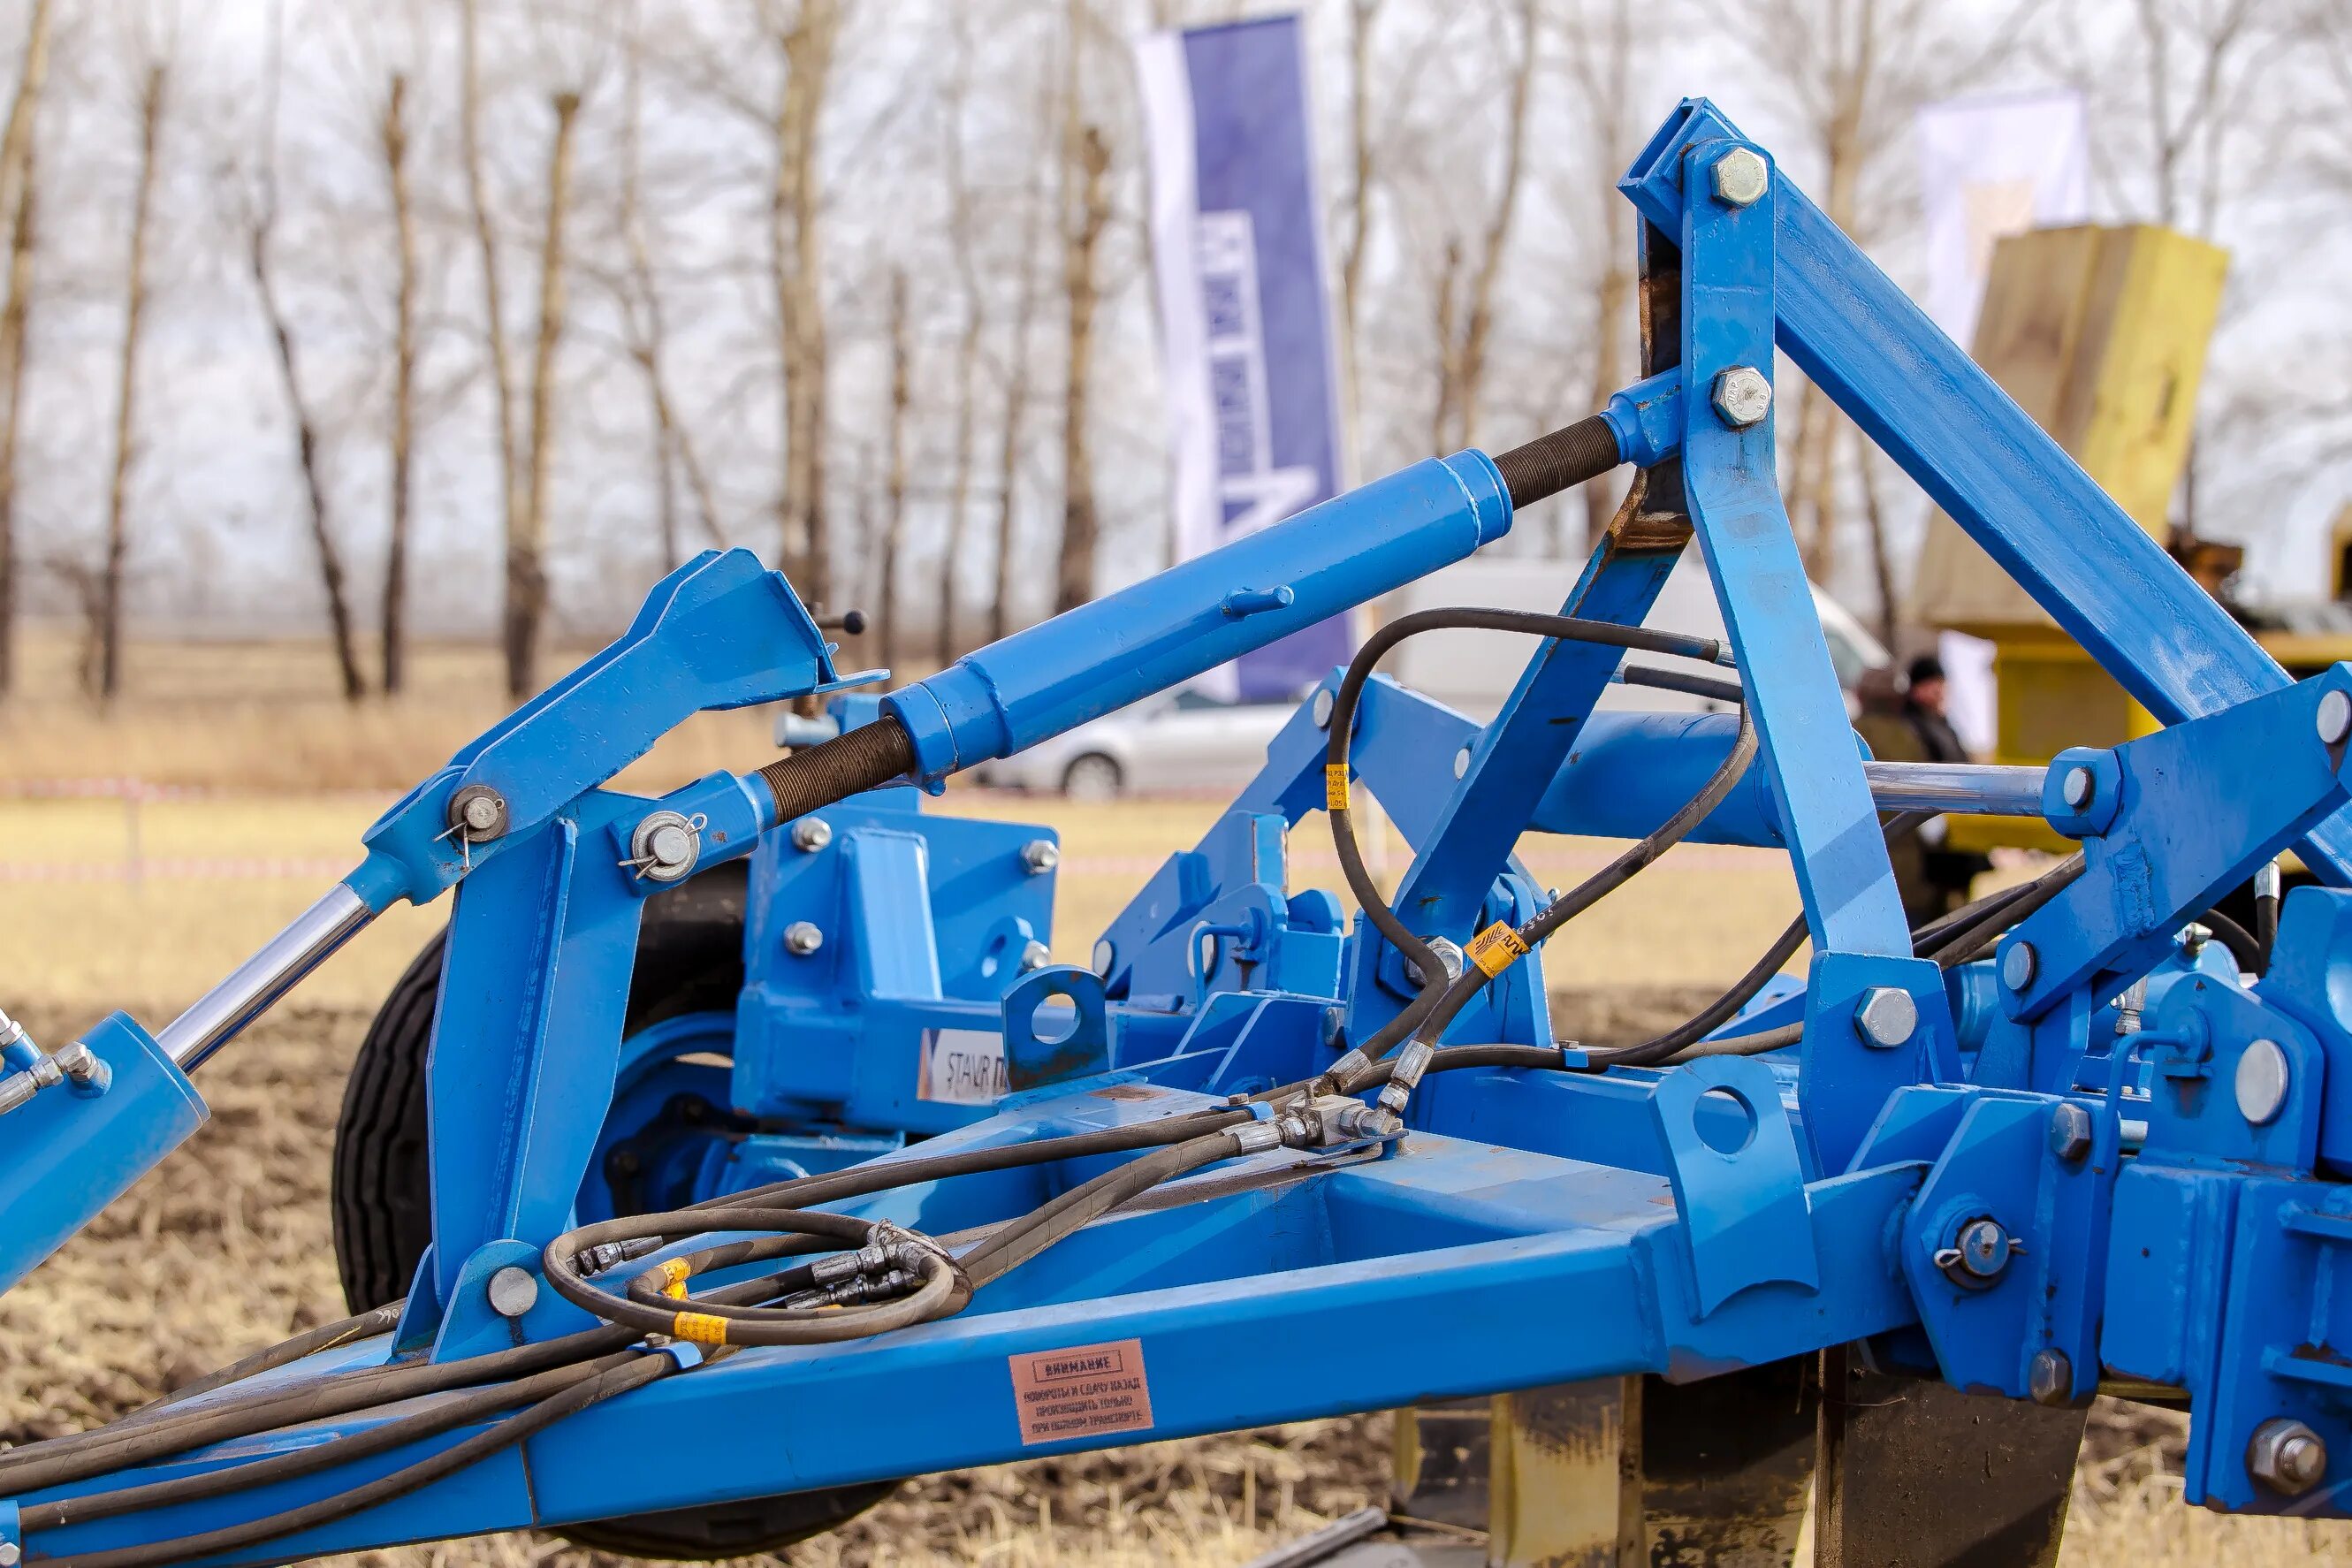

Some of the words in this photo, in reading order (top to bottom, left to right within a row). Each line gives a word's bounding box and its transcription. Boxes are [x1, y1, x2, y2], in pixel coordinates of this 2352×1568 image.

[1046, 1356, 1111, 1376] ВНИМАНИЕ
[1080, 1382, 1108, 1397] СДАЧУ
[1110, 1377, 1141, 1391] НАЗАД
